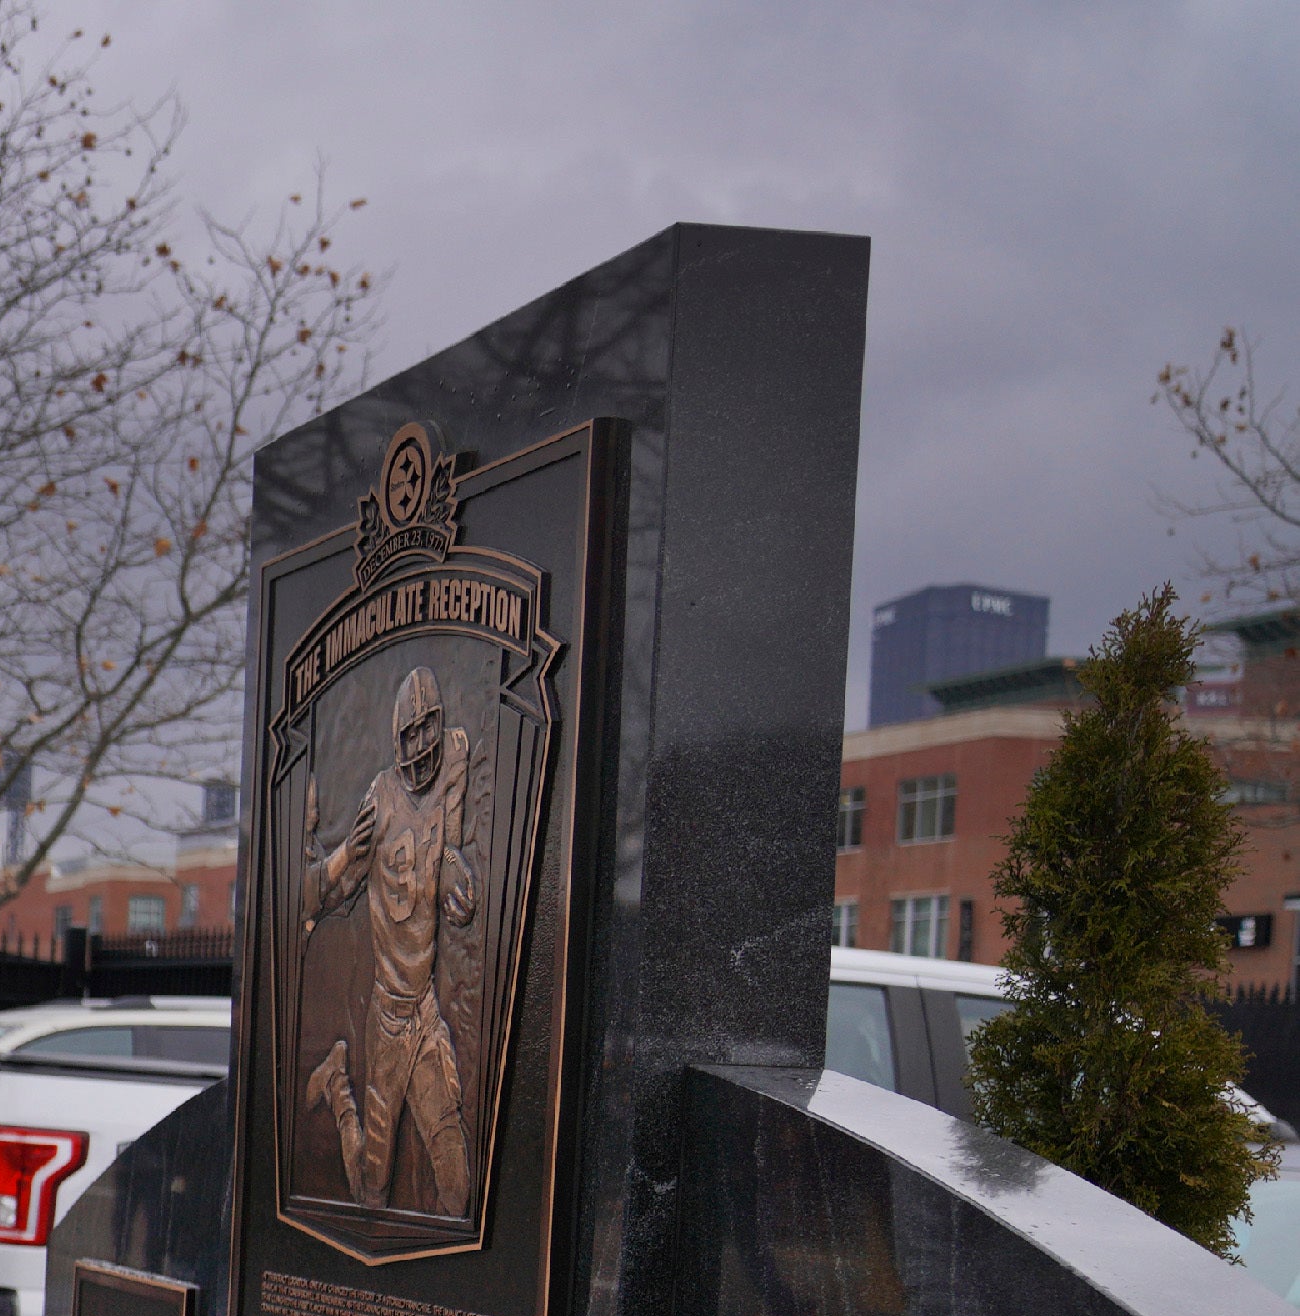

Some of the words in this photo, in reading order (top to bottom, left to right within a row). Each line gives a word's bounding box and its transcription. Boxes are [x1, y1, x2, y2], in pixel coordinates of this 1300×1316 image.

[361, 534, 410, 581] DECEMBER
[295, 645, 321, 703] THE
[325, 581, 425, 672] IMMACULATE
[428, 578, 522, 640] RECEPTION
